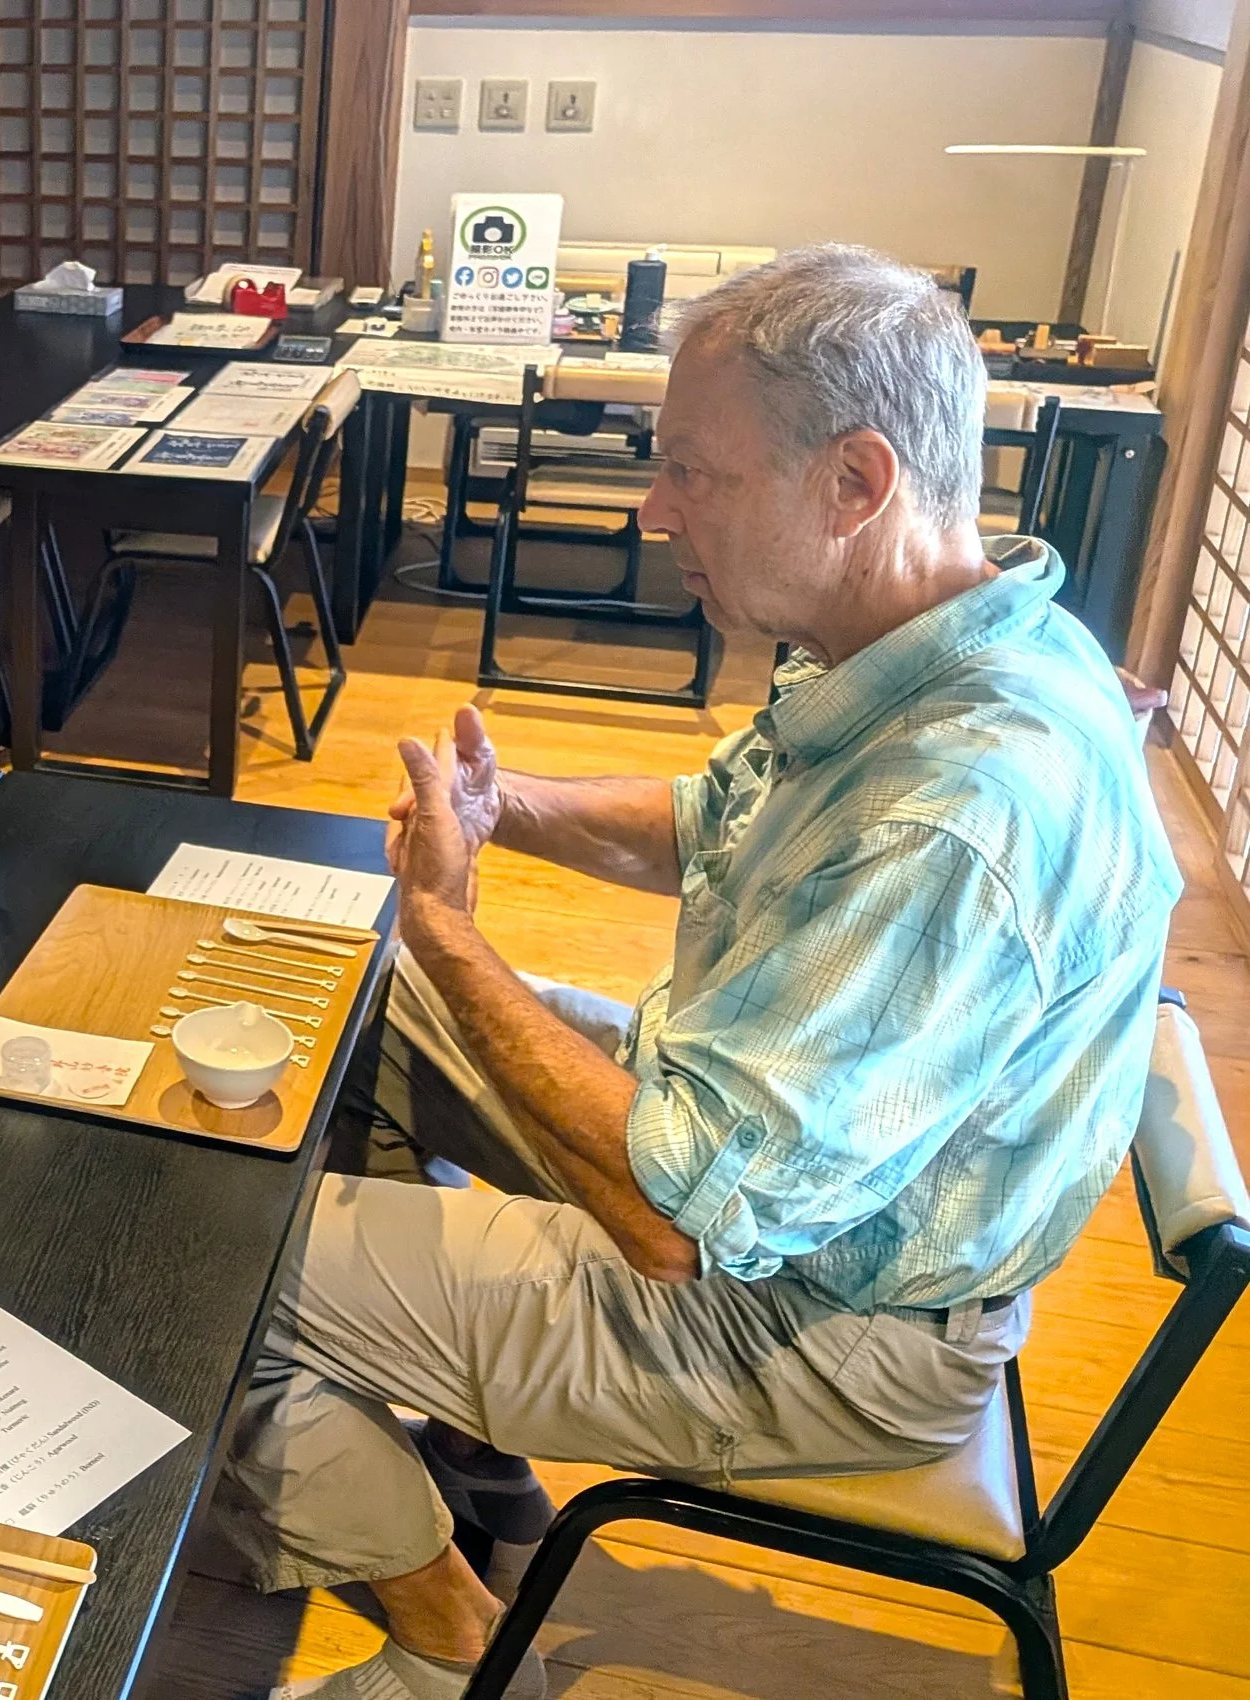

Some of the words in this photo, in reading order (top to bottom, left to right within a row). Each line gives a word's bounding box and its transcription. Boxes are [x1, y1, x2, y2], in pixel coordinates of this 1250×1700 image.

[0, 1414, 30, 1434] Turmeric
[47, 1411, 83, 1437] Sandalwood
[47, 1433, 79, 1457] Agarwood
[79, 1452, 106, 1472] Borneol
